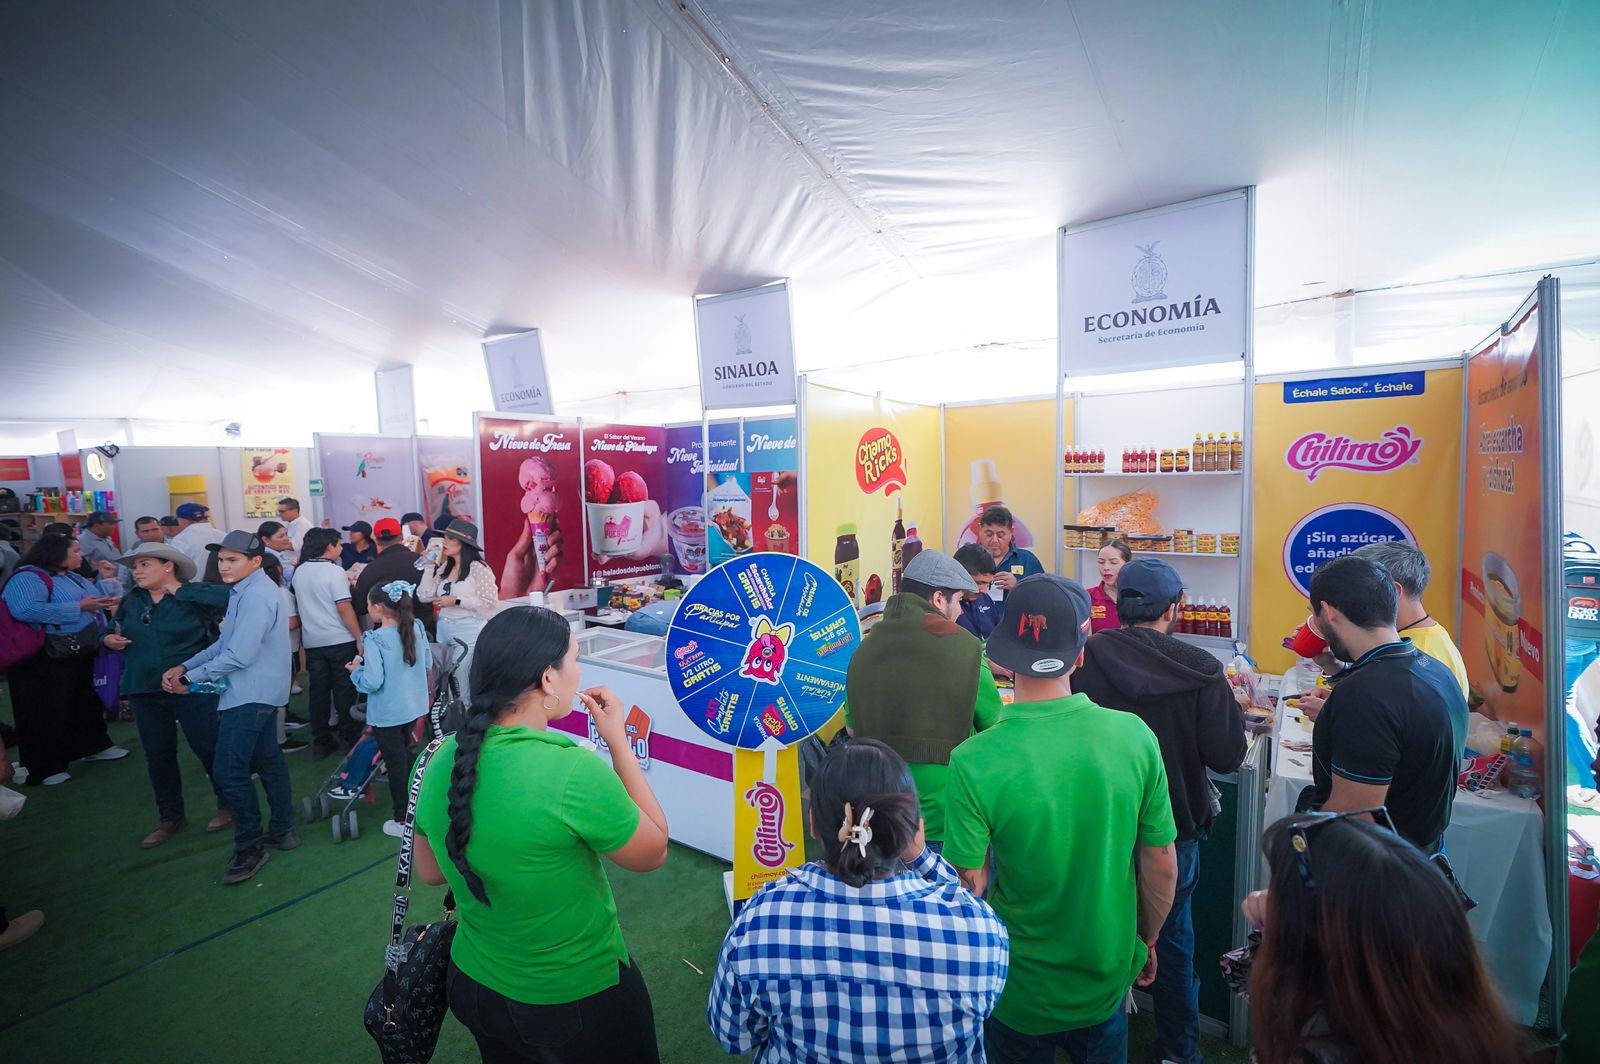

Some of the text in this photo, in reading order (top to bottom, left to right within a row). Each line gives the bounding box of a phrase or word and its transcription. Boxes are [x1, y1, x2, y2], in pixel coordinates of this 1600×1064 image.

[1083, 294, 1222, 333] ECONOMÍA
[1097, 323, 1205, 344] Secretaría de Economía
[714, 361, 779, 381] SINALOA
[1292, 387, 1328, 398] Échale
[1374, 381, 1414, 393] Échale
[489, 431, 571, 452] Nieve de Fresa
[591, 439, 616, 451] Nieve
[616, 441, 624, 451] de
[746, 433, 797, 453] Nieve de
[858, 433, 892, 465] Chamo
[667, 447, 698, 464] Nieve
[1286, 426, 1422, 480] Chilimoy
[690, 458, 738, 475] Inividual
[864, 446, 898, 485] Rick's
[1306, 532, 1396, 545] ¡Sin azúcar
[737, 571, 761, 609] GRATIS
[749, 563, 774, 610] Escarchador
[760, 568, 776, 598] CHAROLA
[693, 603, 741, 622] GRACIAS POR
[1568, 606, 1599, 615] ECKO
[808, 617, 847, 641] GRATIS
[836, 627, 848, 637] 155
[1520, 629, 1540, 662] Nuevo
[682, 668, 695, 679] 1/2
[693, 657, 715, 673] LITRO
[683, 662, 722, 689] GRATIS
[795, 672, 846, 691] NUEVAMENTE
[705, 699, 719, 719] KIT
[721, 693, 740, 733] GRATIS
[776, 696, 799, 731] GRATIS
[398, 767, 425, 876] KAMEL REINA
[745, 781, 796, 868] Chilimoy
